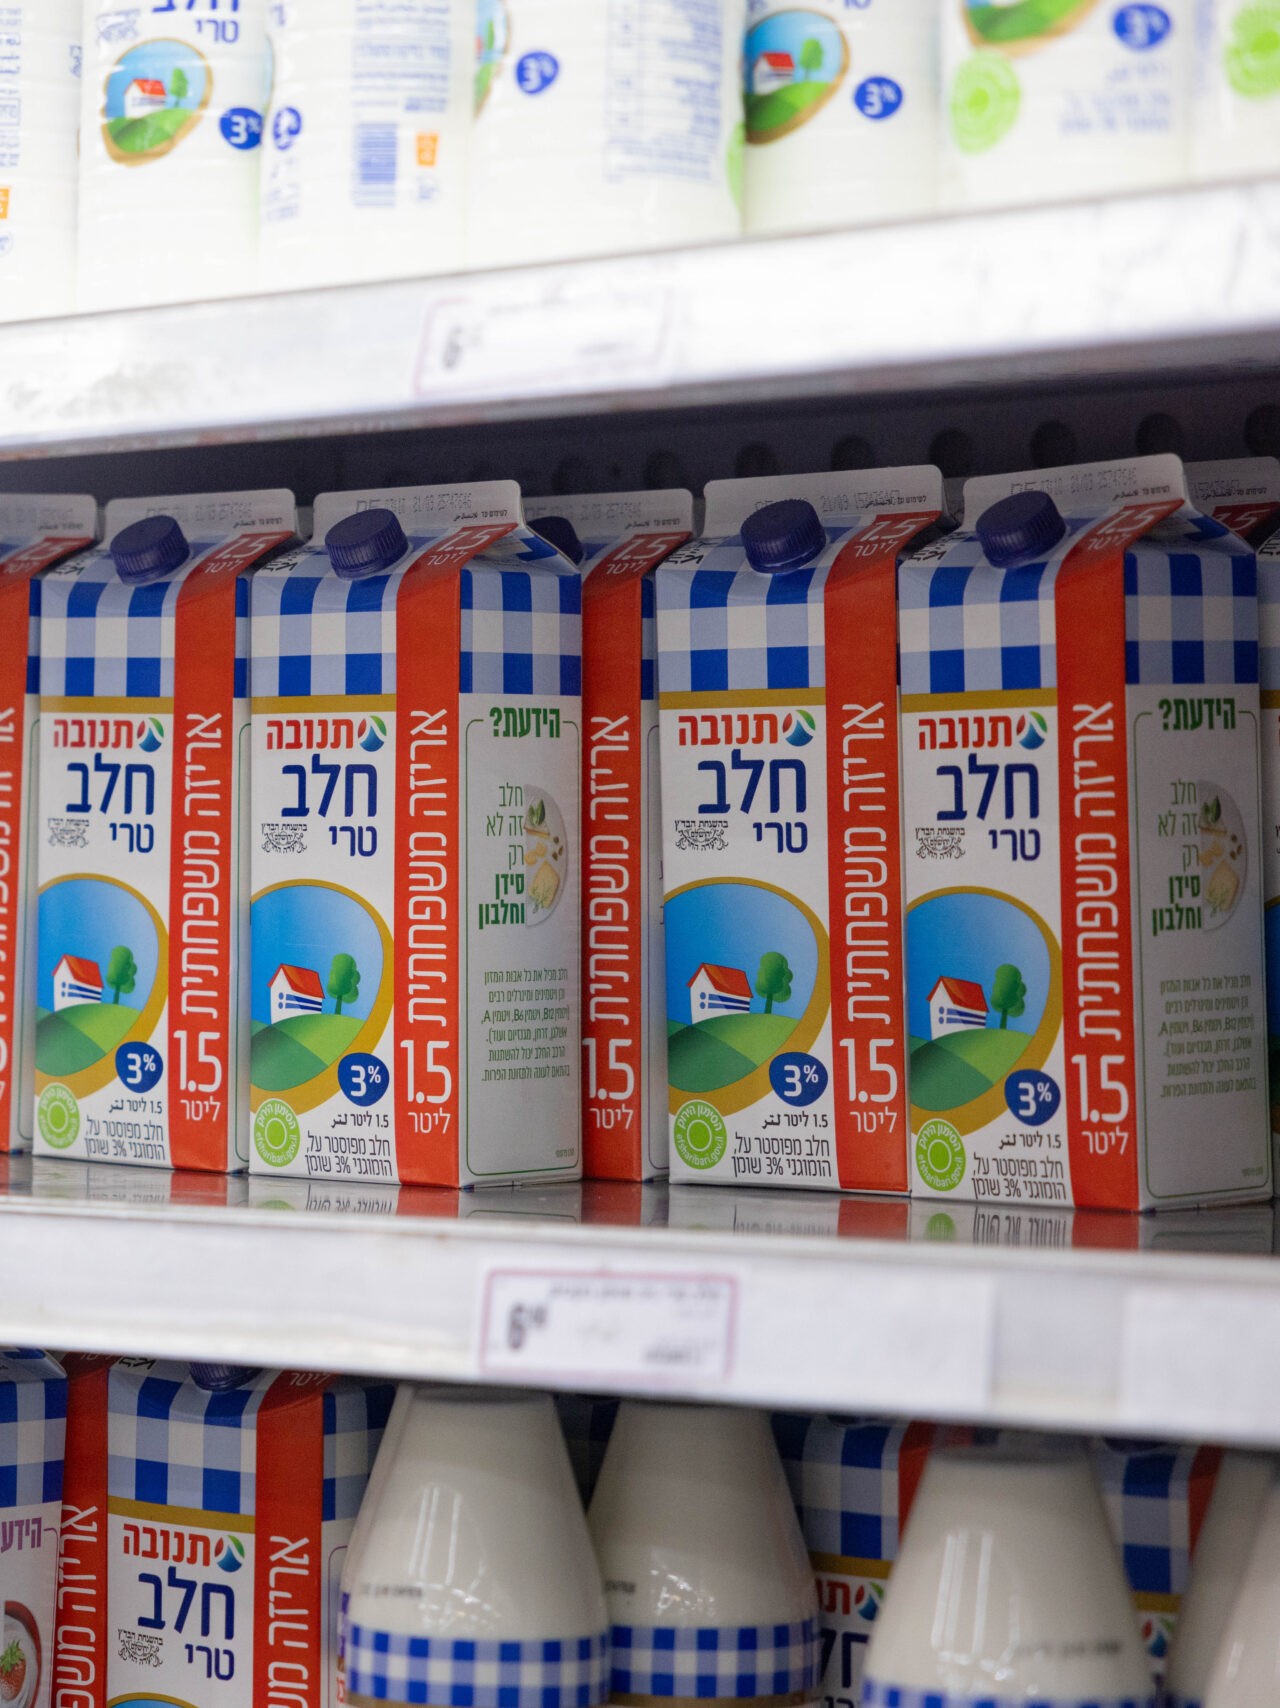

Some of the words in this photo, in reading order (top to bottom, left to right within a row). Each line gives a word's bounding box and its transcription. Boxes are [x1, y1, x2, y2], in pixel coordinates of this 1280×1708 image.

[196, 20, 239, 44] טרי
[853, 539, 899, 558] ליטר
[1087, 534, 1130, 550] ליטר
[427, 551, 468, 566] ליטר
[606, 560, 648, 574] ליטר
[489, 707, 560, 738] הידעת?
[1158, 698, 1236, 732] הידעת?
[53, 719, 133, 749] תנובה
[267, 719, 354, 750] תנובה
[678, 713, 778, 746] תנובה
[919, 715, 1012, 751] תנובה
[185, 712, 222, 816] אריזה
[410, 709, 447, 817] אריזה
[590, 714, 630, 821] אריזה
[842, 701, 886, 812] אריזה
[1072, 702, 1116, 818] אריזה
[66, 753, 155, 815] חלב
[281, 753, 377, 818] חלב
[698, 749, 807, 815] חלב
[936, 753, 1040, 821] חלב
[1170, 779, 1198, 806] חלב
[499, 784, 523, 808] חלב
[486, 812, 505, 837] לא
[509, 813, 524, 837] זה
[753, 821, 808, 854] טרי
[1157, 811, 1177, 838] לא
[1182, 813, 1198, 835] זה
[109, 823, 154, 853] טרי
[329, 825, 377, 857] טרי
[988, 829, 1040, 861] טרי
[508, 844, 524, 870] רק
[1182, 845, 1200, 874] רק
[495, 873, 525, 902] סידן
[1169, 874, 1201, 902] סידן
[181, 829, 221, 1019] משפחתית
[478, 899, 525, 930] וחלבון
[844, 827, 890, 1025] משפחתית
[1152, 905, 1202, 936] וחלבון
[408, 832, 447, 1027] משפחתית
[589, 834, 629, 1026] משפחתית
[1075, 832, 1121, 1041] משפחתית
[484, 971, 504, 986] המזון
[489, 990, 505, 1003] רבים
[127, 1053, 156, 1084] 3%
[174, 1030, 222, 1092] 1.5
[400, 1039, 452, 1104] 1.5
[582, 1038, 635, 1101] 1.5
[840, 1039, 898, 1103] 1.5
[350, 1065, 381, 1097] 3%
[784, 1065, 819, 1097] 3%
[1071, 1054, 1129, 1123] 1.5
[127, 1097, 147, 1112] ליטר
[150, 1101, 162, 1114] 1.5
[180, 1098, 221, 1122] ליטר
[1018, 1082, 1052, 1116] 3%
[103, 1120, 141, 1139] מפוסטר
[144, 1121, 164, 1141] חלב
[350, 1111, 372, 1127] ליטר
[377, 1114, 389, 1128] 1.5
[408, 1108, 451, 1134] ליטר
[589, 1105, 634, 1130] ליטר
[784, 1111, 809, 1127] ליטר
[814, 1114, 828, 1128] 1.5
[849, 1107, 898, 1134] ליטר
[84, 1137, 109, 1157] שומן
[113, 1139, 127, 1157] 3%
[324, 1136, 366, 1155] מפוסטר
[368, 1135, 390, 1156] חלב
[754, 1136, 801, 1156] מפוסטר
[806, 1135, 830, 1156] חלב
[1019, 1131, 1043, 1148] ליטר
[1047, 1135, 1061, 1149] 1.5
[1081, 1128, 1129, 1155] ליטר
[305, 1154, 332, 1175] שומן
[335, 1155, 351, 1173] 3%
[353, 1157, 393, 1177] הומוגני
[731, 1155, 761, 1178] שומן
[766, 1156, 784, 1175] 3%
[788, 1158, 831, 1178] הומוגני
[992, 1157, 1037, 1178] מפוסטר
[1040, 1156, 1064, 1179] חלב
[972, 1177, 1000, 1201] שומן
[1003, 1178, 1021, 1198] 3%
[1024, 1180, 1066, 1200] הומוגני
[289, 1371, 330, 1387] ליטר
[58, 1504, 98, 1613] אריזה
[123, 1523, 210, 1567] תנובה
[137, 1566, 235, 1641] חלב
[268, 1535, 310, 1649] אריזה
[185, 1643, 235, 1681] טרי
